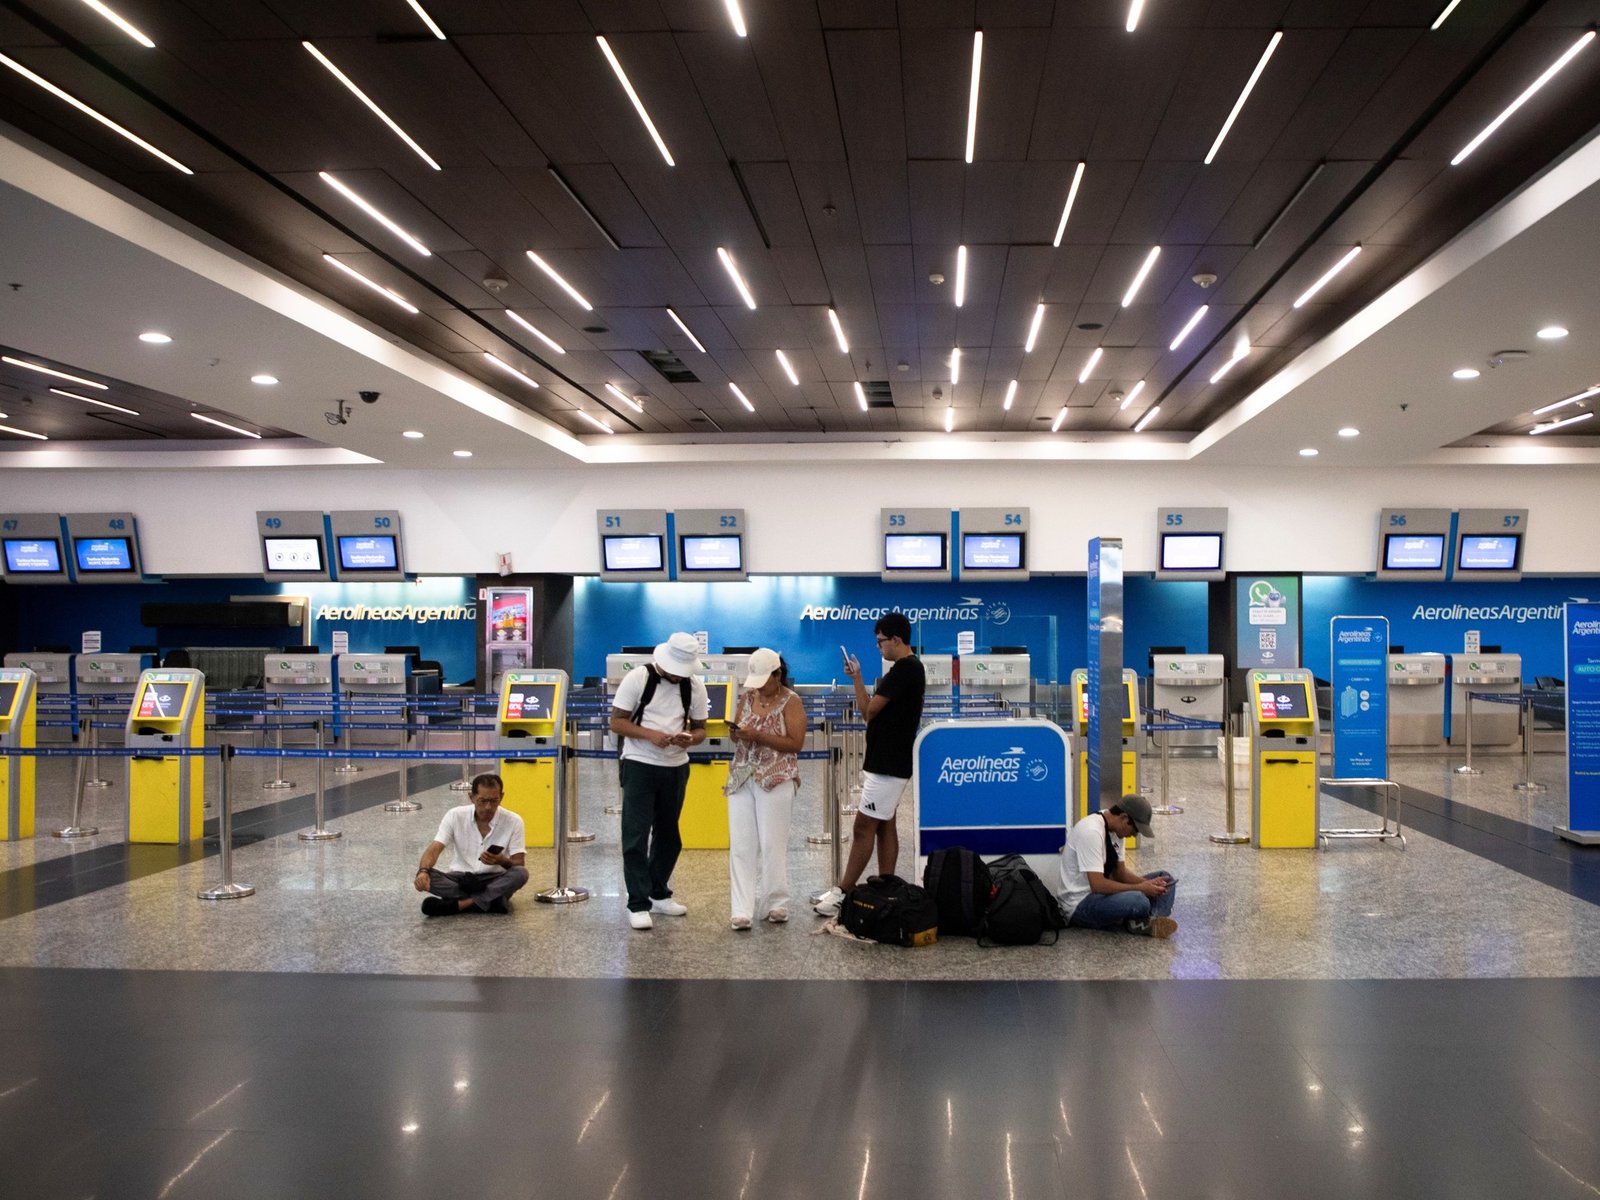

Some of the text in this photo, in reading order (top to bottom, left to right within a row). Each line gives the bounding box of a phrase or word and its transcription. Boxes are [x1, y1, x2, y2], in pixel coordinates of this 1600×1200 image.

[3, 520, 18, 530] 47
[109, 519, 125, 530] 48
[265, 518, 281, 528] 49
[374, 517, 390, 528] 50
[606, 516, 621, 527] 51
[720, 516, 737, 527] 52
[889, 515, 906, 526] 53
[1004, 514, 1022, 525] 54
[1166, 515, 1183, 525] 55
[1390, 515, 1406, 526] 56
[1503, 516, 1520, 527] 57
[400, 604, 477, 624] Argentina
[800, 604, 889, 621] Aerolíneas
[1412, 604, 1499, 621] Aerolíneas
[941, 756, 1020, 771] Aerolíneas
[937, 770, 1018, 786] Argentinas
